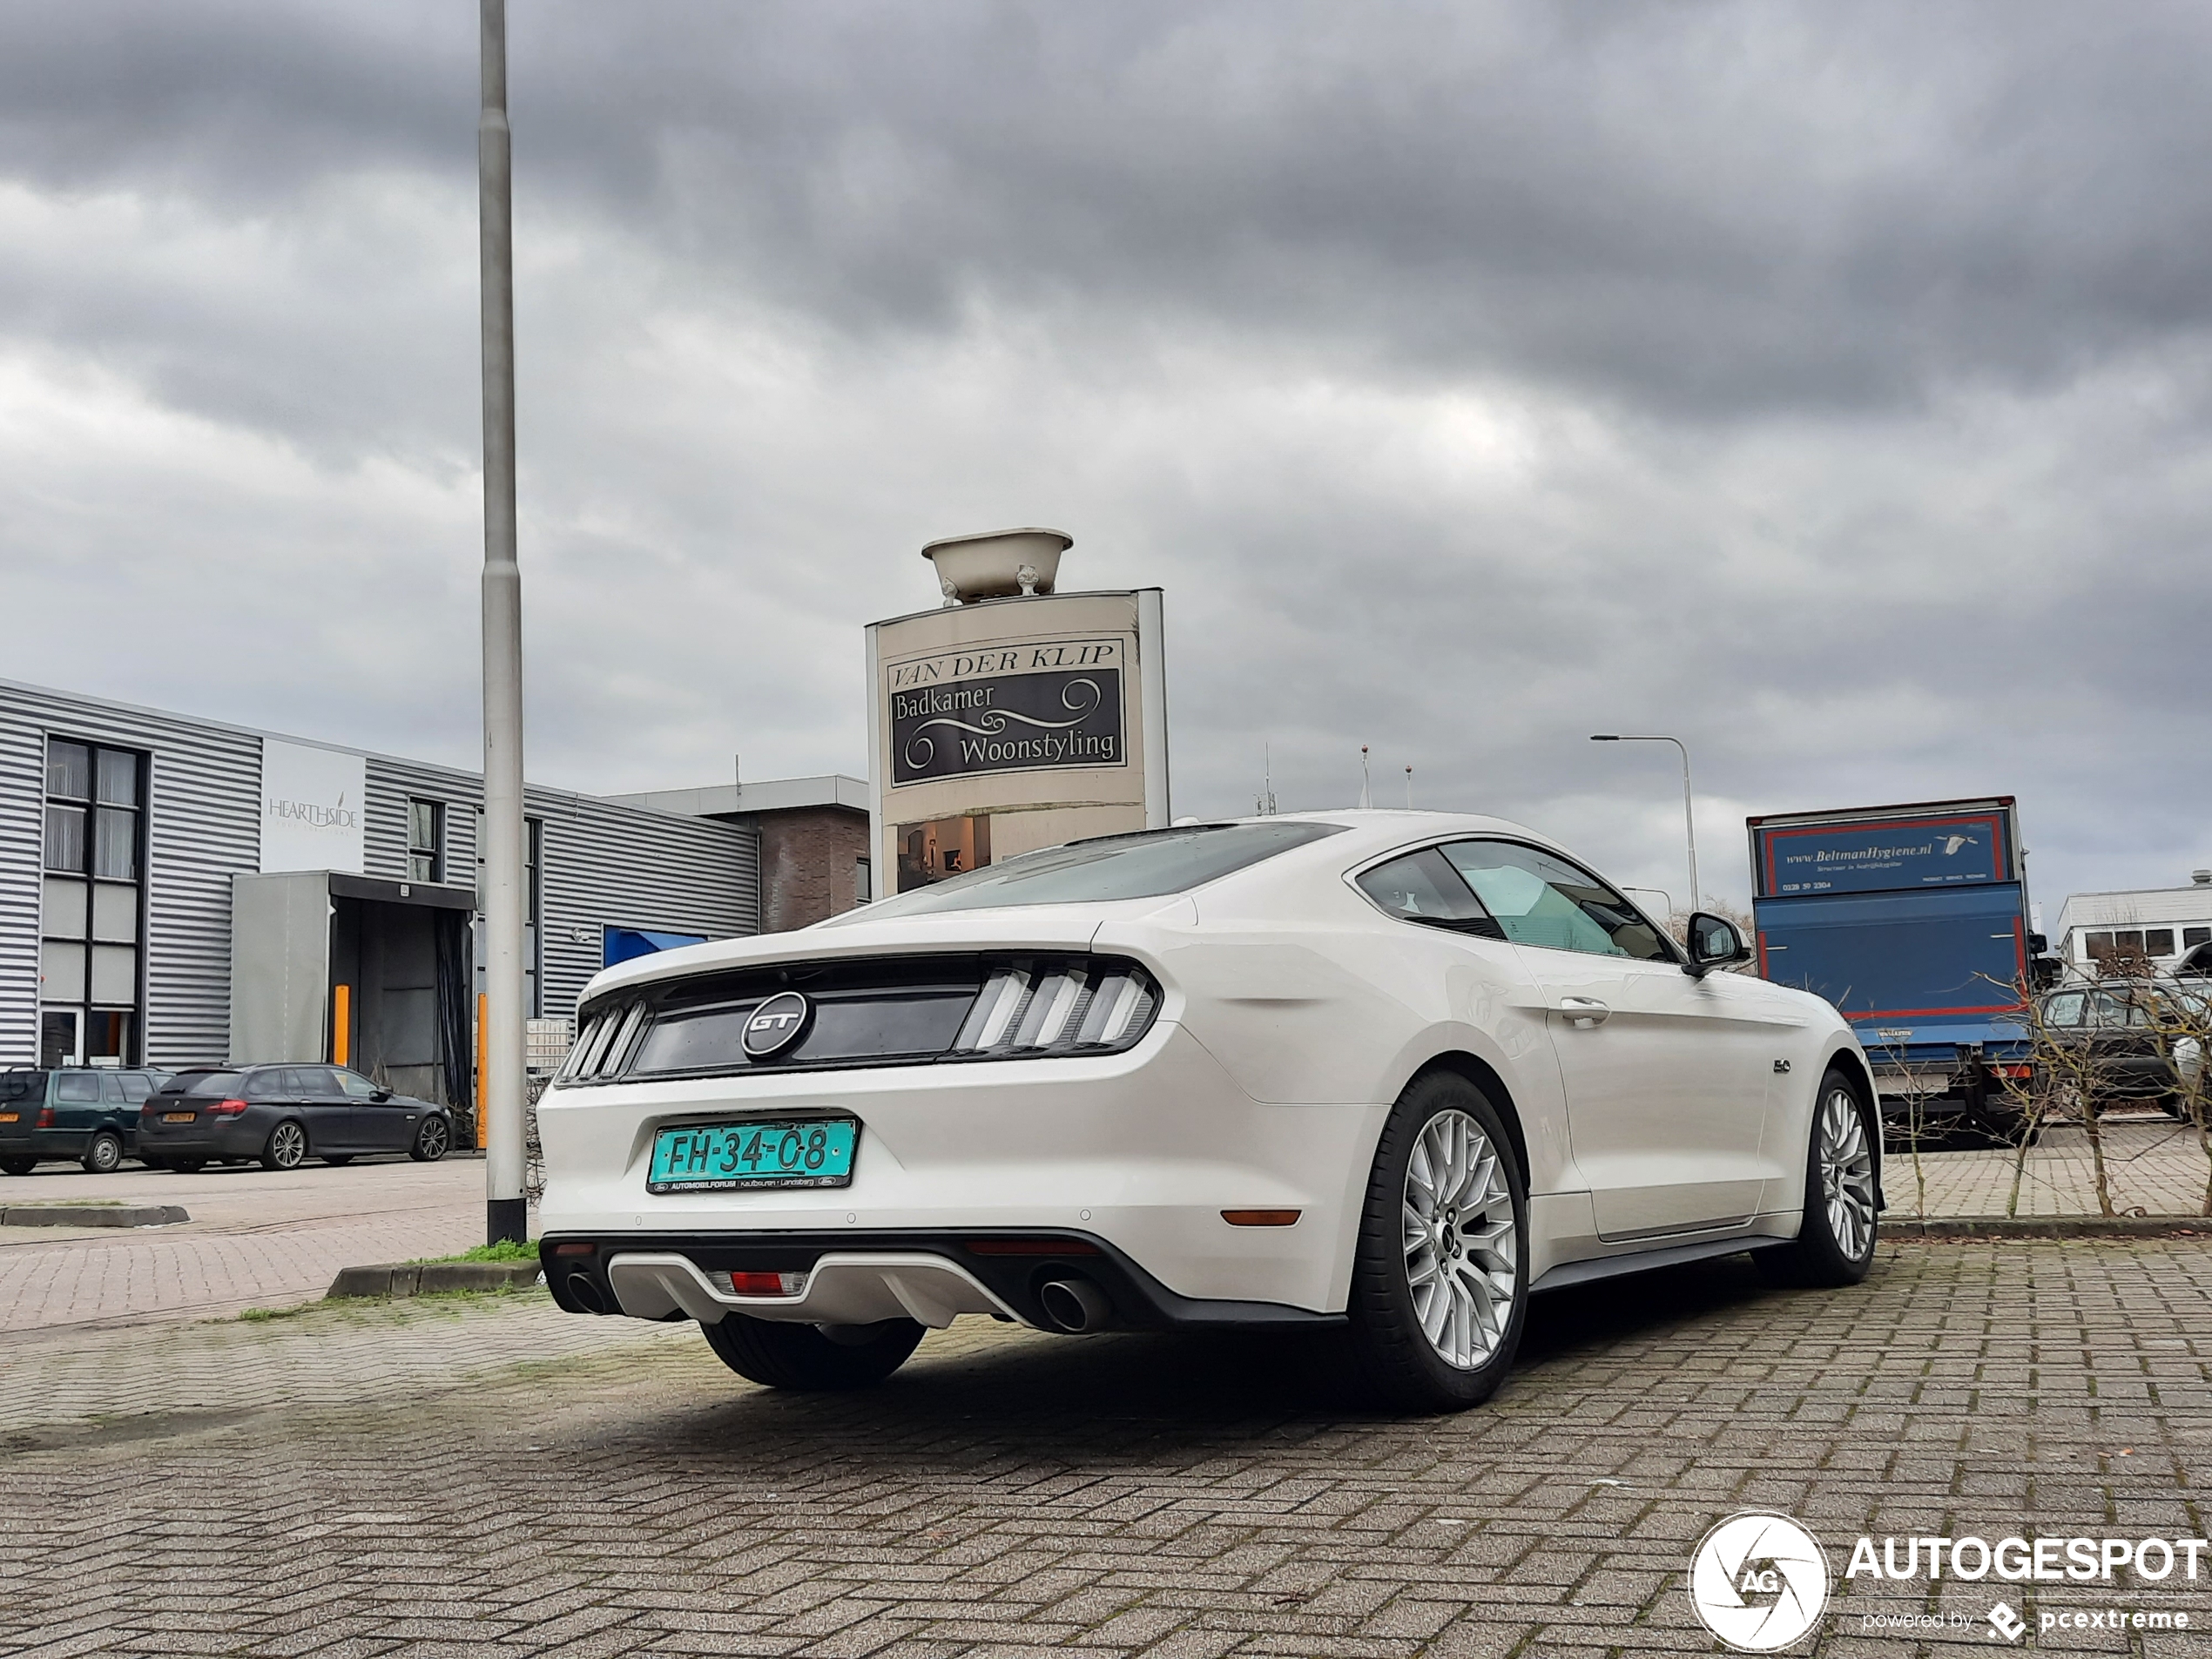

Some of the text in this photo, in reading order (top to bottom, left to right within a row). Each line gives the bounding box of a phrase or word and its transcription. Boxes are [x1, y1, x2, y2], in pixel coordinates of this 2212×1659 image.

[895, 644, 1114, 686] VAN DER KLIP
[895, 685, 995, 721] Badkamer
[960, 729, 1115, 764] Woonstyling
[269, 798, 357, 828] HEARTHSIDE
[1786, 843, 1932, 865] www.BeltmanHygiene.nl
[750, 1013, 799, 1031] GT
[668, 1130, 827, 1174] FH-34-08
